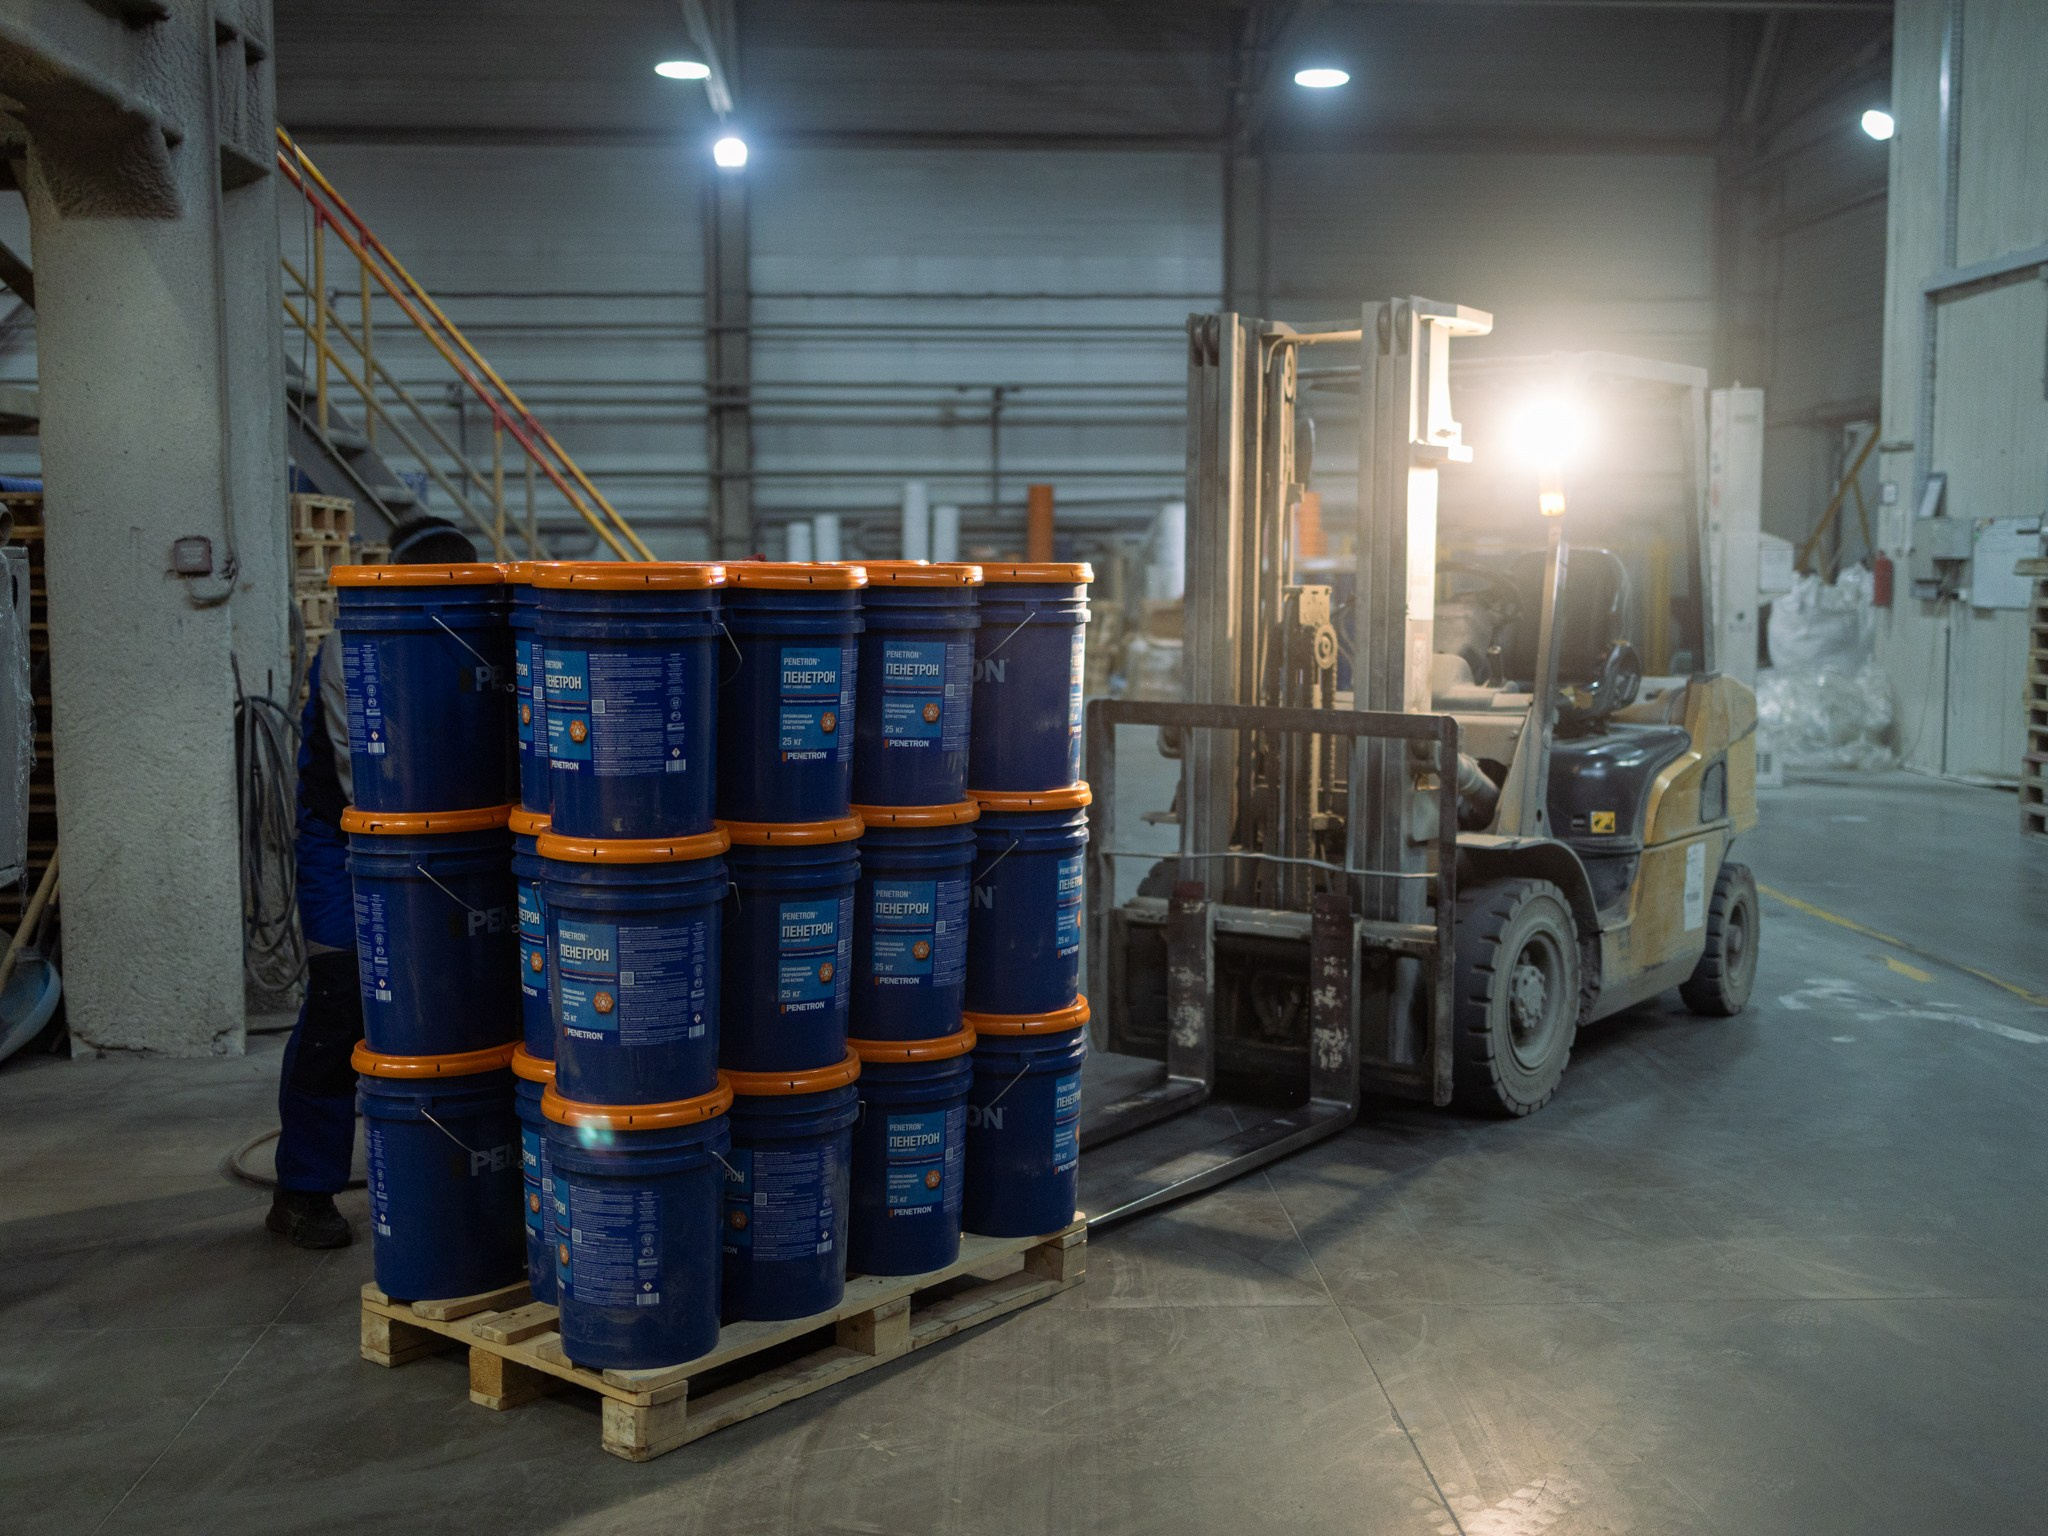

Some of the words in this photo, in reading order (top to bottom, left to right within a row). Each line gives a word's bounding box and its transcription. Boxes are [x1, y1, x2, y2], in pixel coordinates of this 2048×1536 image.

[886, 663, 939, 676] ПЕНЕТРОН
[784, 671, 836, 684] ПЕНЕТРОН
[885, 725, 894, 733] 25
[782, 737, 792, 746] 25
[889, 739, 930, 748] PENETRON
[787, 751, 827, 760] PENETRON
[875, 902, 929, 914] ПЕНЕТРОН
[782, 922, 833, 938] ПЕНЕТРОН
[560, 944, 609, 962] ПЕНЕТРОН
[874, 962, 884, 971] 25
[879, 976, 920, 985] PENETRON
[781, 990, 791, 998] 25
[786, 1001, 825, 1011] PENETRON
[563, 1011, 570, 1021] 25
[567, 1027, 603, 1041] PENETRON
[889, 1132, 940, 1147] ПЕНЕТРОН
[889, 1195, 898, 1203] 25
[894, 1206, 932, 1216] PENETRON
